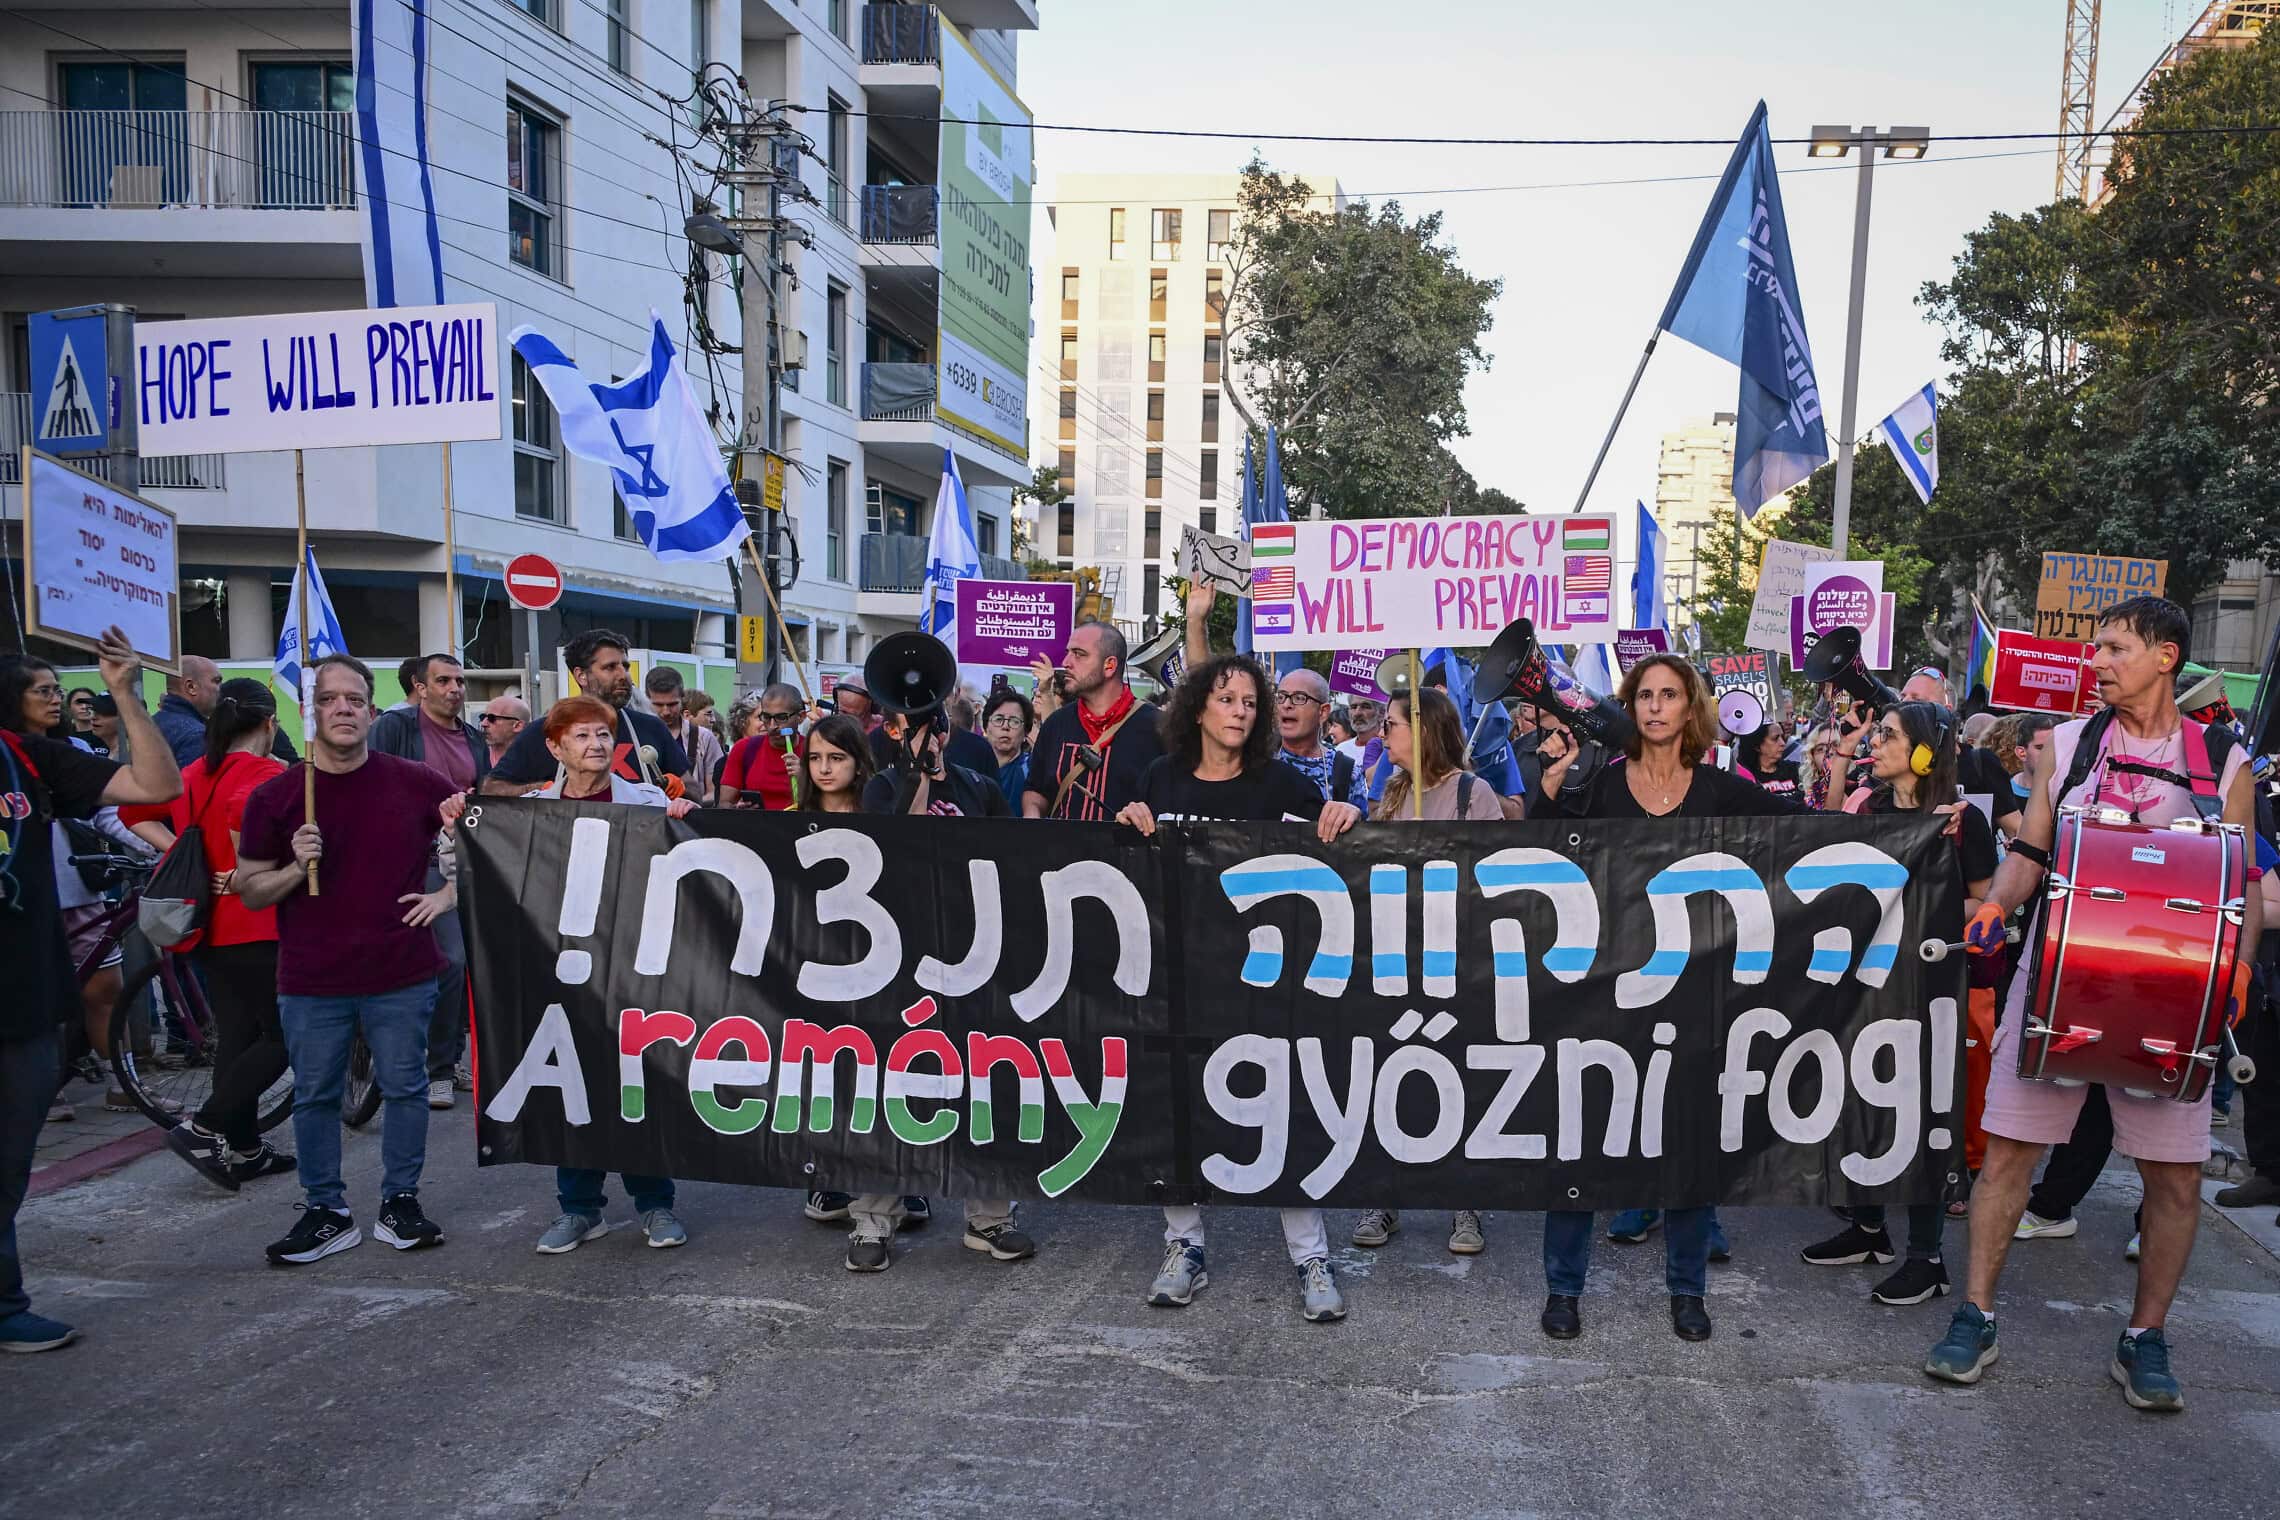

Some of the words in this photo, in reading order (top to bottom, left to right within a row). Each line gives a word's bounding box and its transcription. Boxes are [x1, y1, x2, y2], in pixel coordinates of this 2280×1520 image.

[947, 182, 1000, 250] פנטהאוז
[1003, 229, 1025, 272] מגה
[966, 240, 1011, 297] למכירה
[140, 339, 232, 425] HOPE
[263, 332, 356, 413] WILL
[366, 318, 494, 409] PREVAIL
[995, 385, 1022, 421] BROSH
[83, 492, 107, 516] היא
[79, 528, 105, 551] יסוד
[1330, 519, 1555, 573] DEMOCRACY
[120, 546, 156, 573] כרסום
[2045, 554, 2123, 583] הונגריה
[2125, 561, 2158, 588] גם
[981, 602, 1033, 613] דמוקרטיה
[1297, 577, 1384, 634] WILL
[1434, 574, 1572, 632] PREVAIL
[1817, 589, 1850, 601] שלום
[1851, 591, 1868, 602] רק
[2068, 583, 2117, 611] פולין
[1035, 605, 1050, 615] אין
[1815, 611, 1846, 621] ביטחון
[1847, 611, 1868, 619] יביא
[748, 617, 756, 653] 4071
[980, 626, 1035, 638] התנחלויות
[1037, 629, 1052, 638] עם
[1340, 664, 1372, 678] תקווה
[1711, 653, 1767, 675] SAVE
[2025, 669, 2072, 686] הביתה!
[555, 816, 1153, 1023] תנצח!
[1219, 841, 1909, 1044] התקווה
[485, 1003, 592, 1127] A
[618, 994, 1128, 1199] remény
[1200, 1007, 1678, 1201] győzni
[1717, 996, 1958, 1188] fog!
